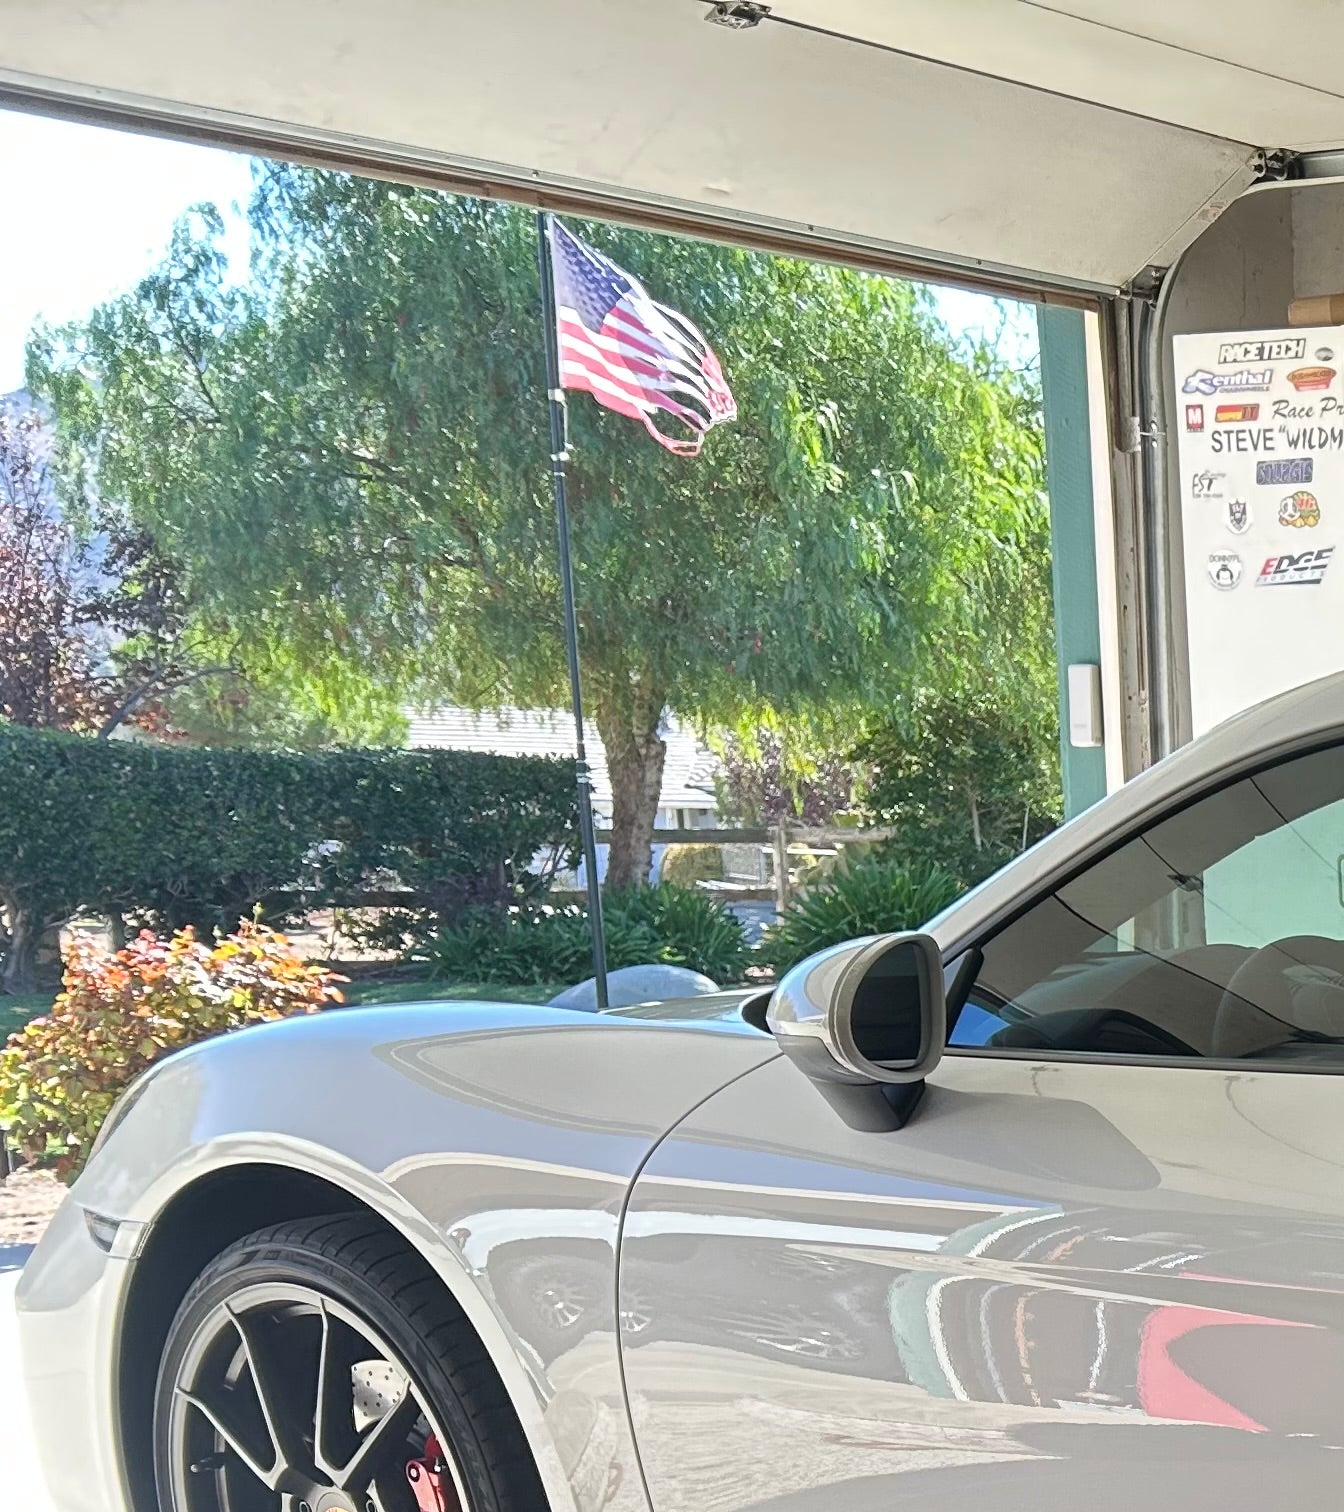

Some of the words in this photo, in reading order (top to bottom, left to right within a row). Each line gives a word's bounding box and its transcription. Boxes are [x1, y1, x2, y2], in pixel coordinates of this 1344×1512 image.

[1272, 400, 1315, 419] Race
[1211, 428, 1275, 452] STEVE
[1260, 547, 1336, 576] EDGE
